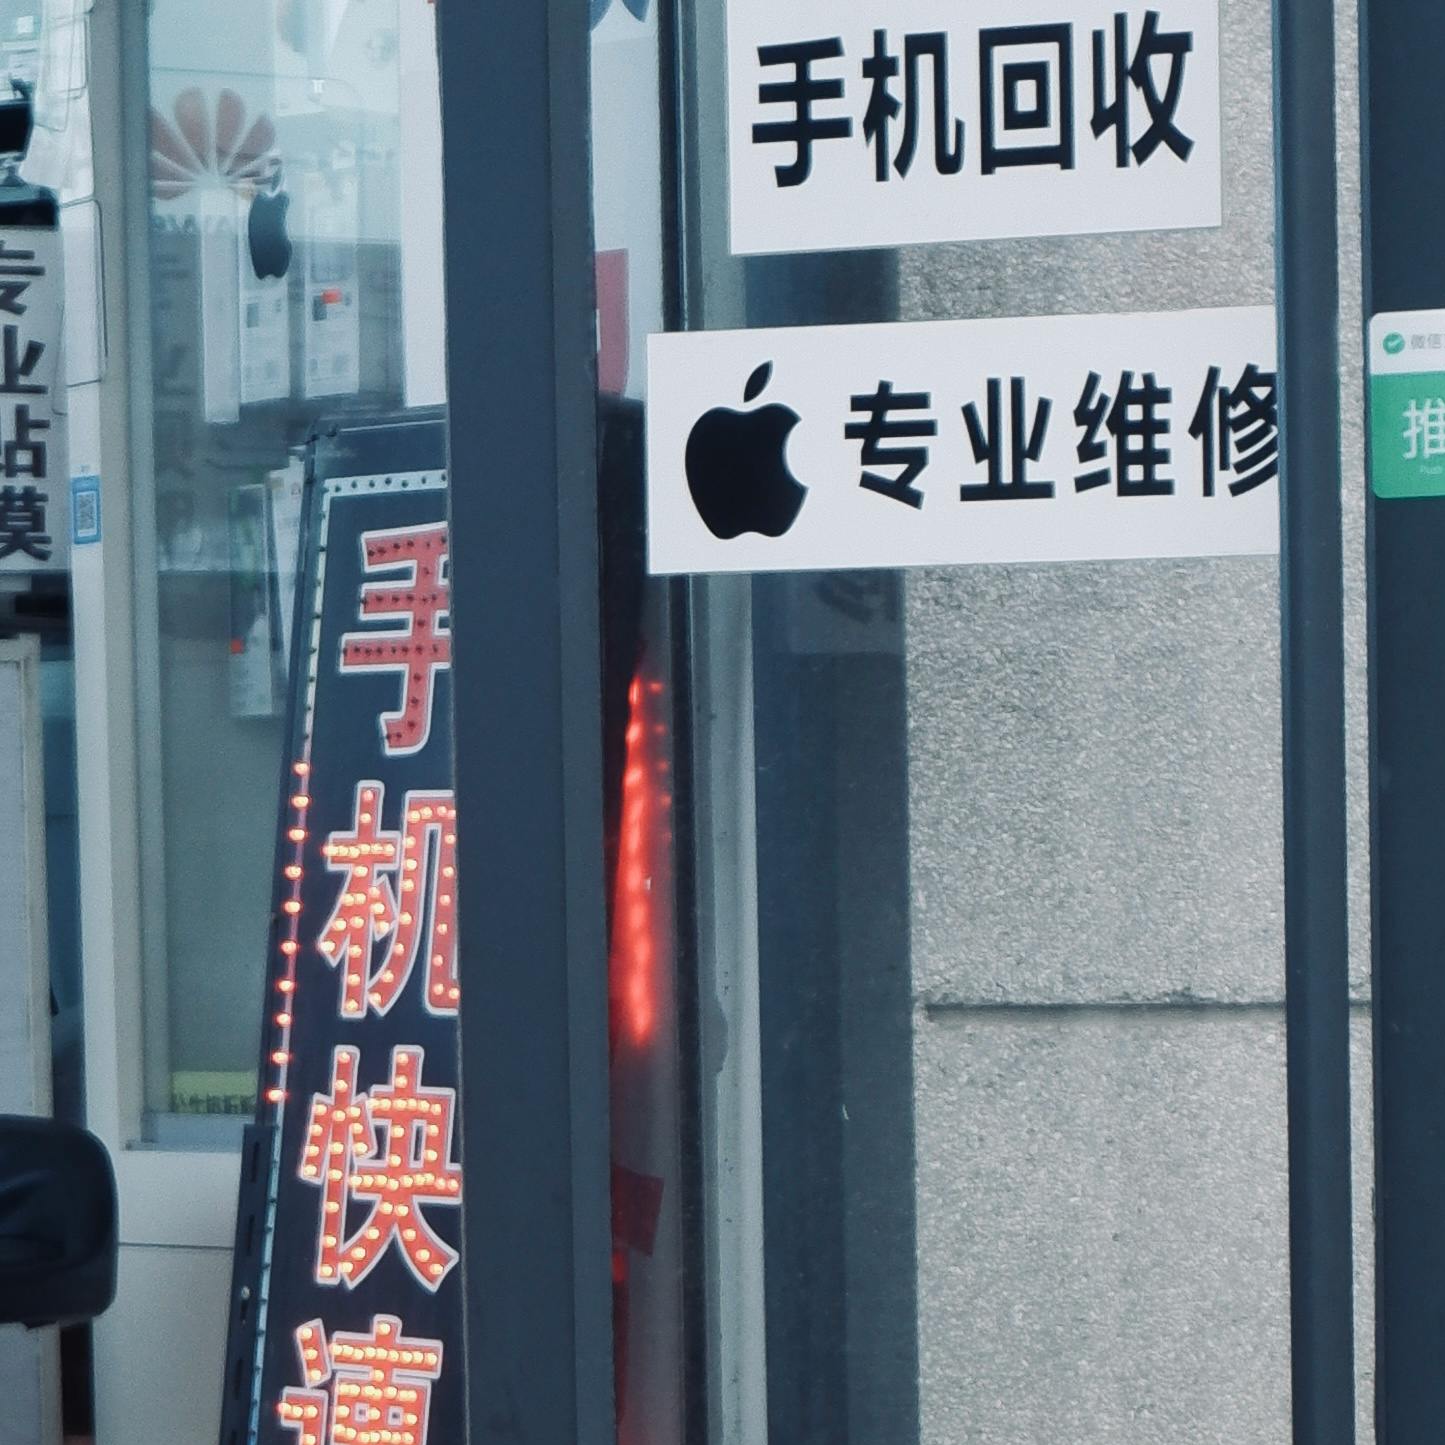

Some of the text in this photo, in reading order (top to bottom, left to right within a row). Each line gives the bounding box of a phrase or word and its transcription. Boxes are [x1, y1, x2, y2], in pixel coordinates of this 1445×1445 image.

[751, 11, 1195, 188] 手机回收
[844, 361, 1279, 510] 专业维修
